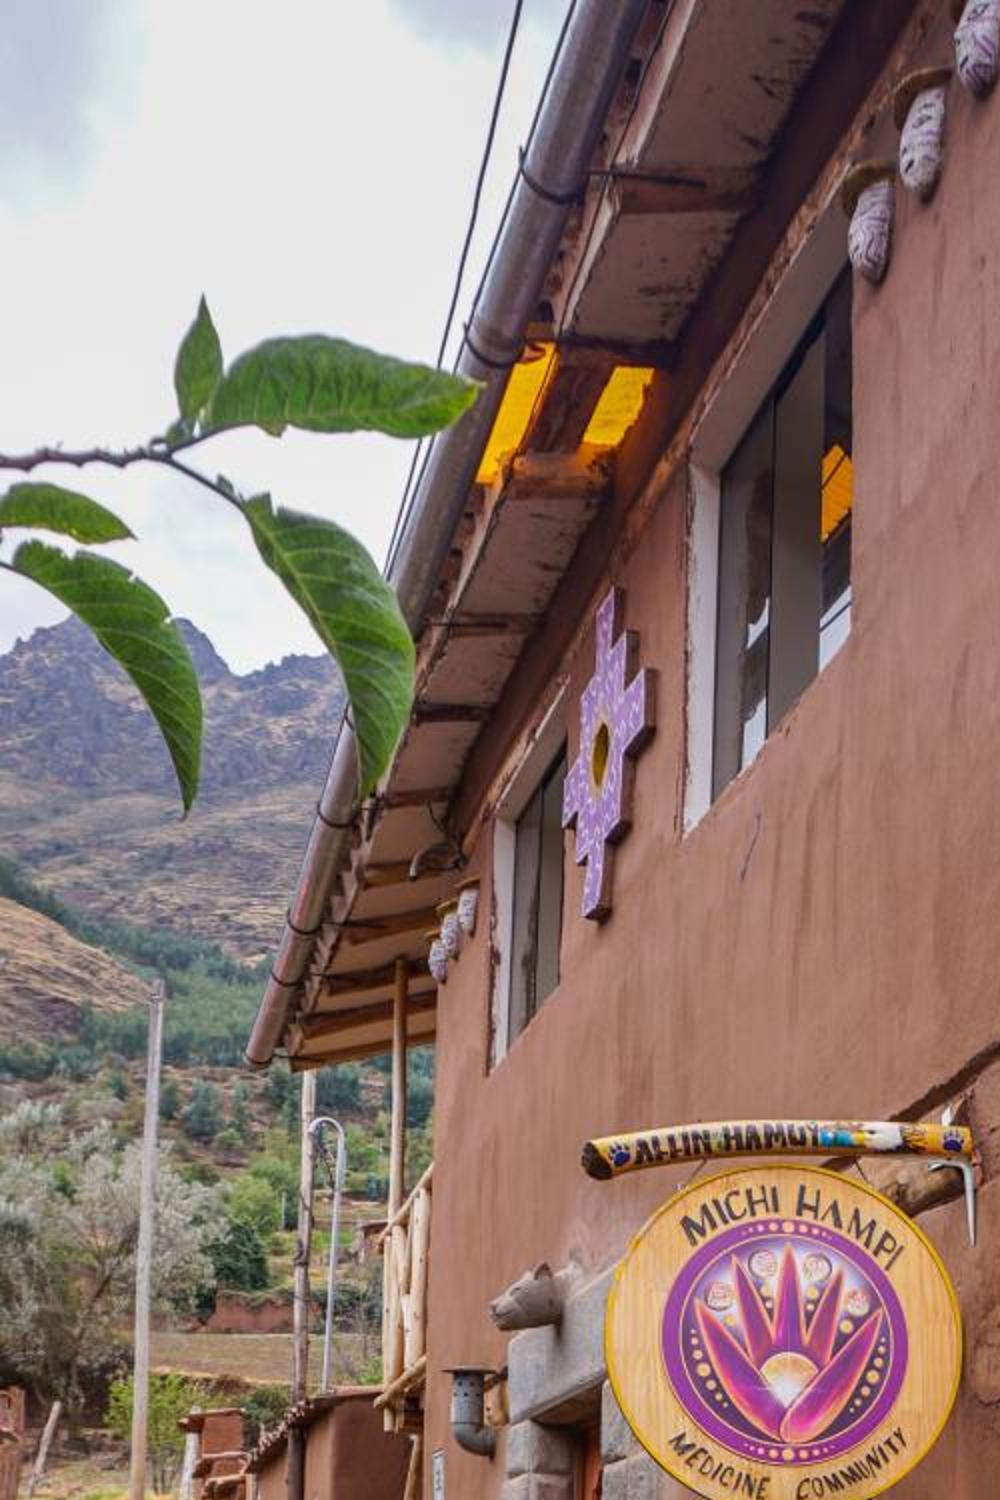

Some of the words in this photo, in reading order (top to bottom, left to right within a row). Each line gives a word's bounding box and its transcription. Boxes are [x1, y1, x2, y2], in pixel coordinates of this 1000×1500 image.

[635, 1129, 712, 1165] ALLIN
[680, 1184, 779, 1247] MICHI
[796, 1184, 905, 1271] HAMPI
[668, 1432, 770, 1500] MEDICINE
